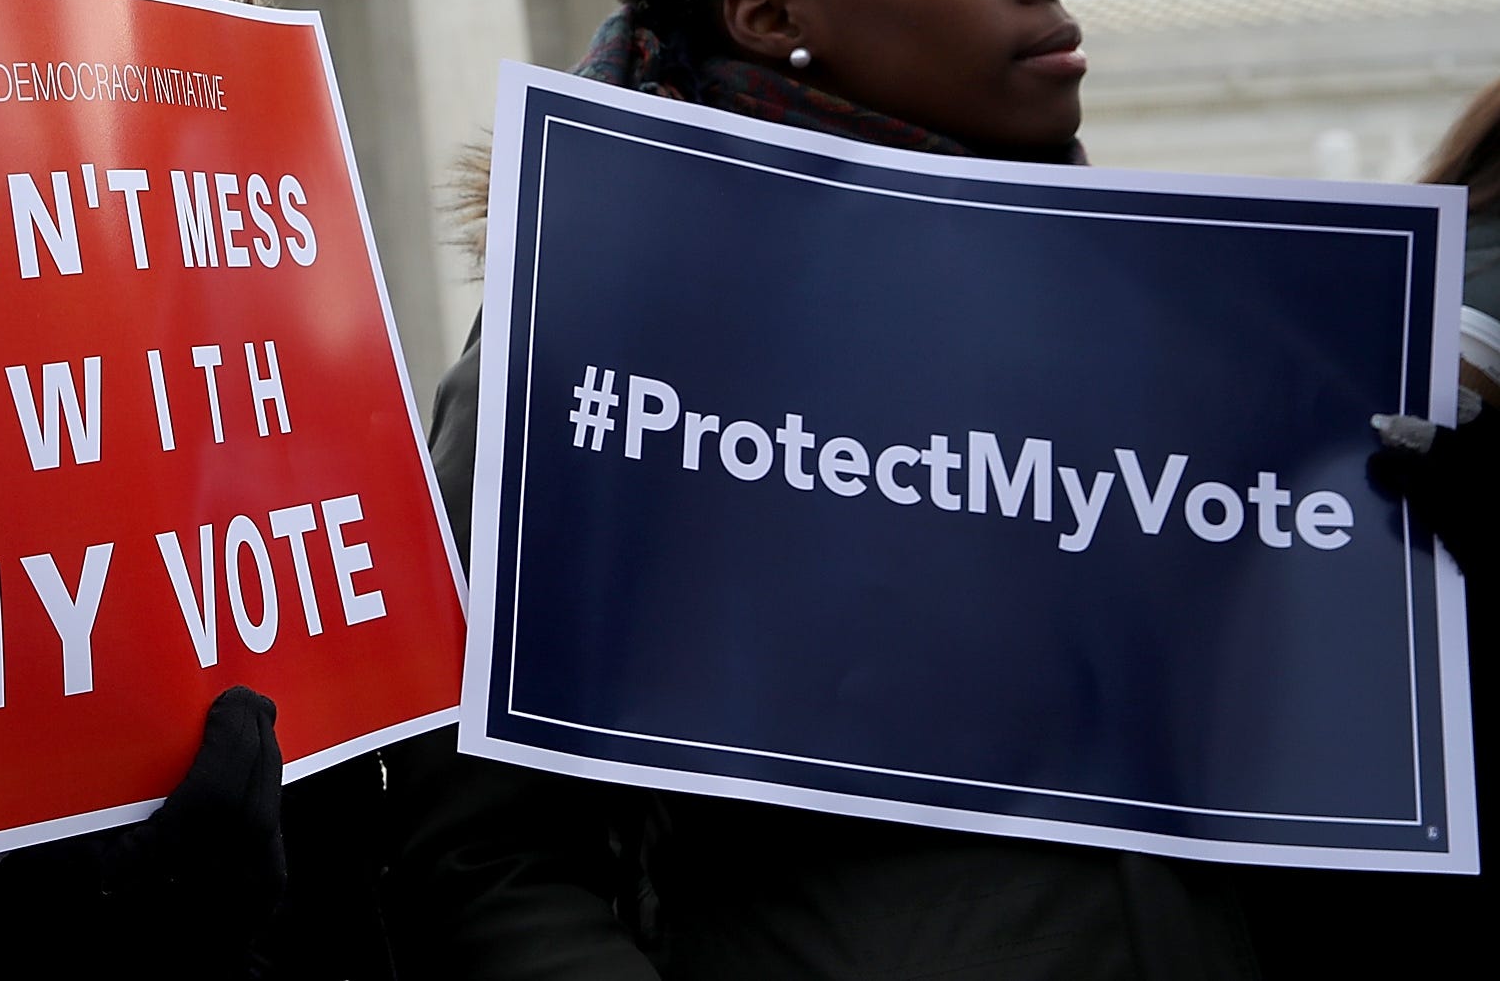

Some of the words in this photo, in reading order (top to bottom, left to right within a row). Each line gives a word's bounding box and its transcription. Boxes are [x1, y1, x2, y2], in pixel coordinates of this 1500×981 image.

[151, 68, 227, 112] INITIATIVE
[170, 170, 318, 269] MESS
[5, 340, 293, 471] WITH
[569, 365, 1356, 554] #ProtectMyVote
[155, 493, 388, 670] VOTE
